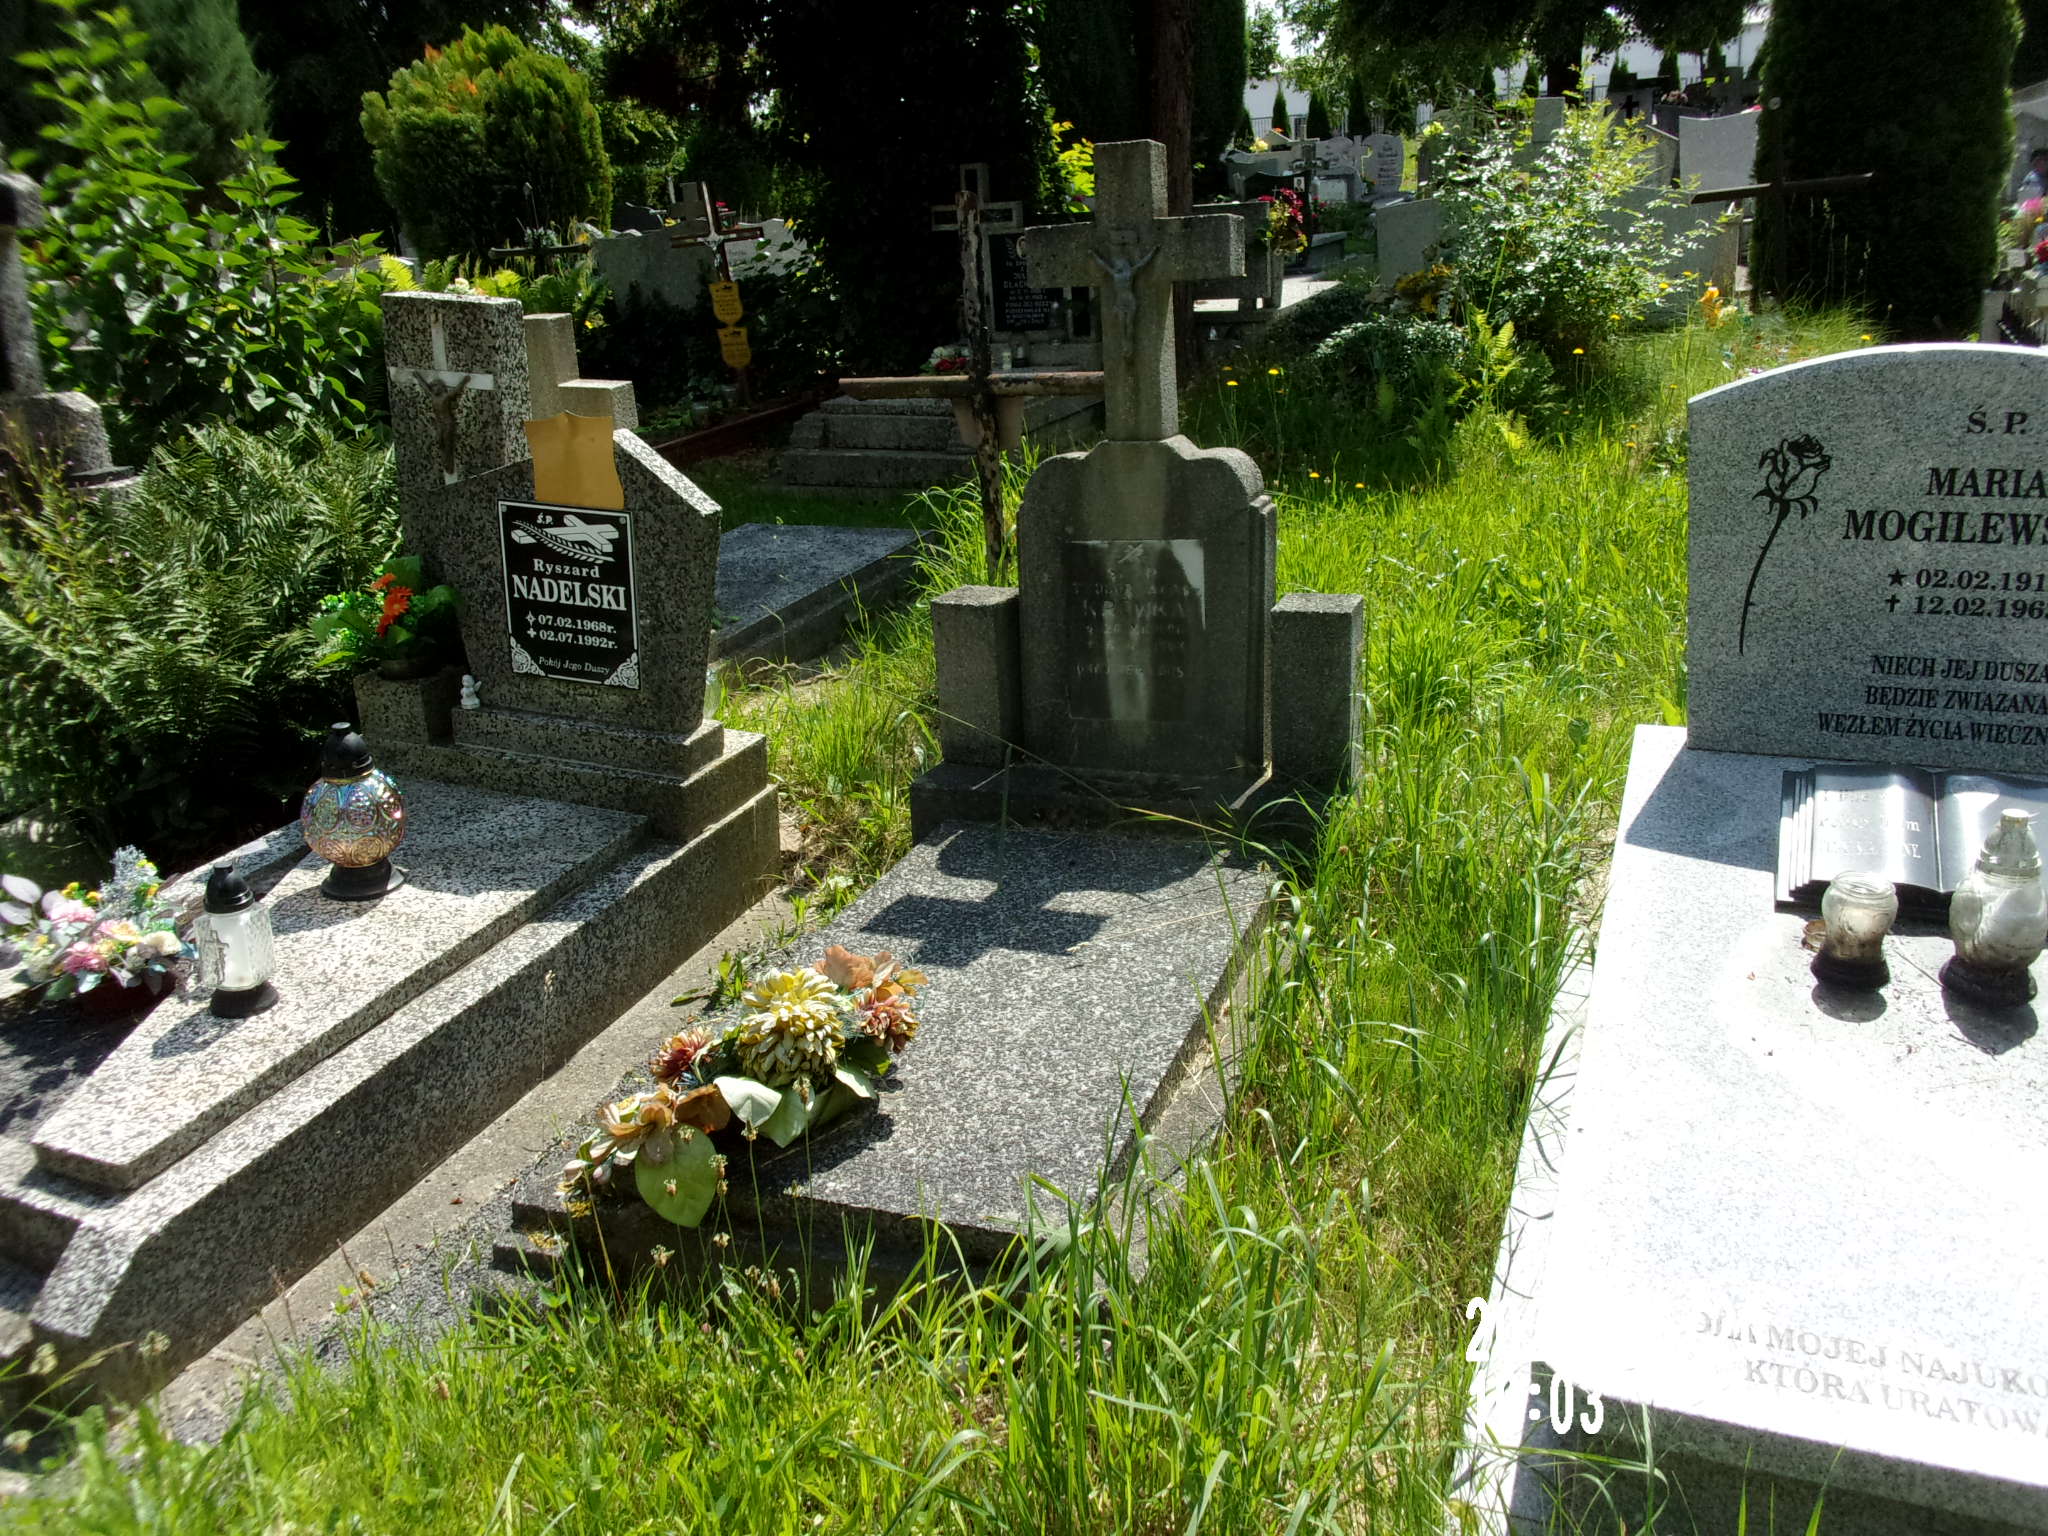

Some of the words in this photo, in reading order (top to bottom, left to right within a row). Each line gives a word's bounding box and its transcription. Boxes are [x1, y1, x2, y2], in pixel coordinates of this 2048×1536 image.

[1925, 467, 2048, 499] MARIA
[532, 558, 600, 579] Ryszard
[511, 574, 627, 612] NADELSKI
[538, 613, 617, 634] 07.02.1968r.
[539, 629, 618, 650] 02.07.1992r.
[1871, 654, 1937, 678] NIECH
[1941, 659, 1980, 682] JEJ
[1765, 1324, 1888, 1369] MOJEJ
